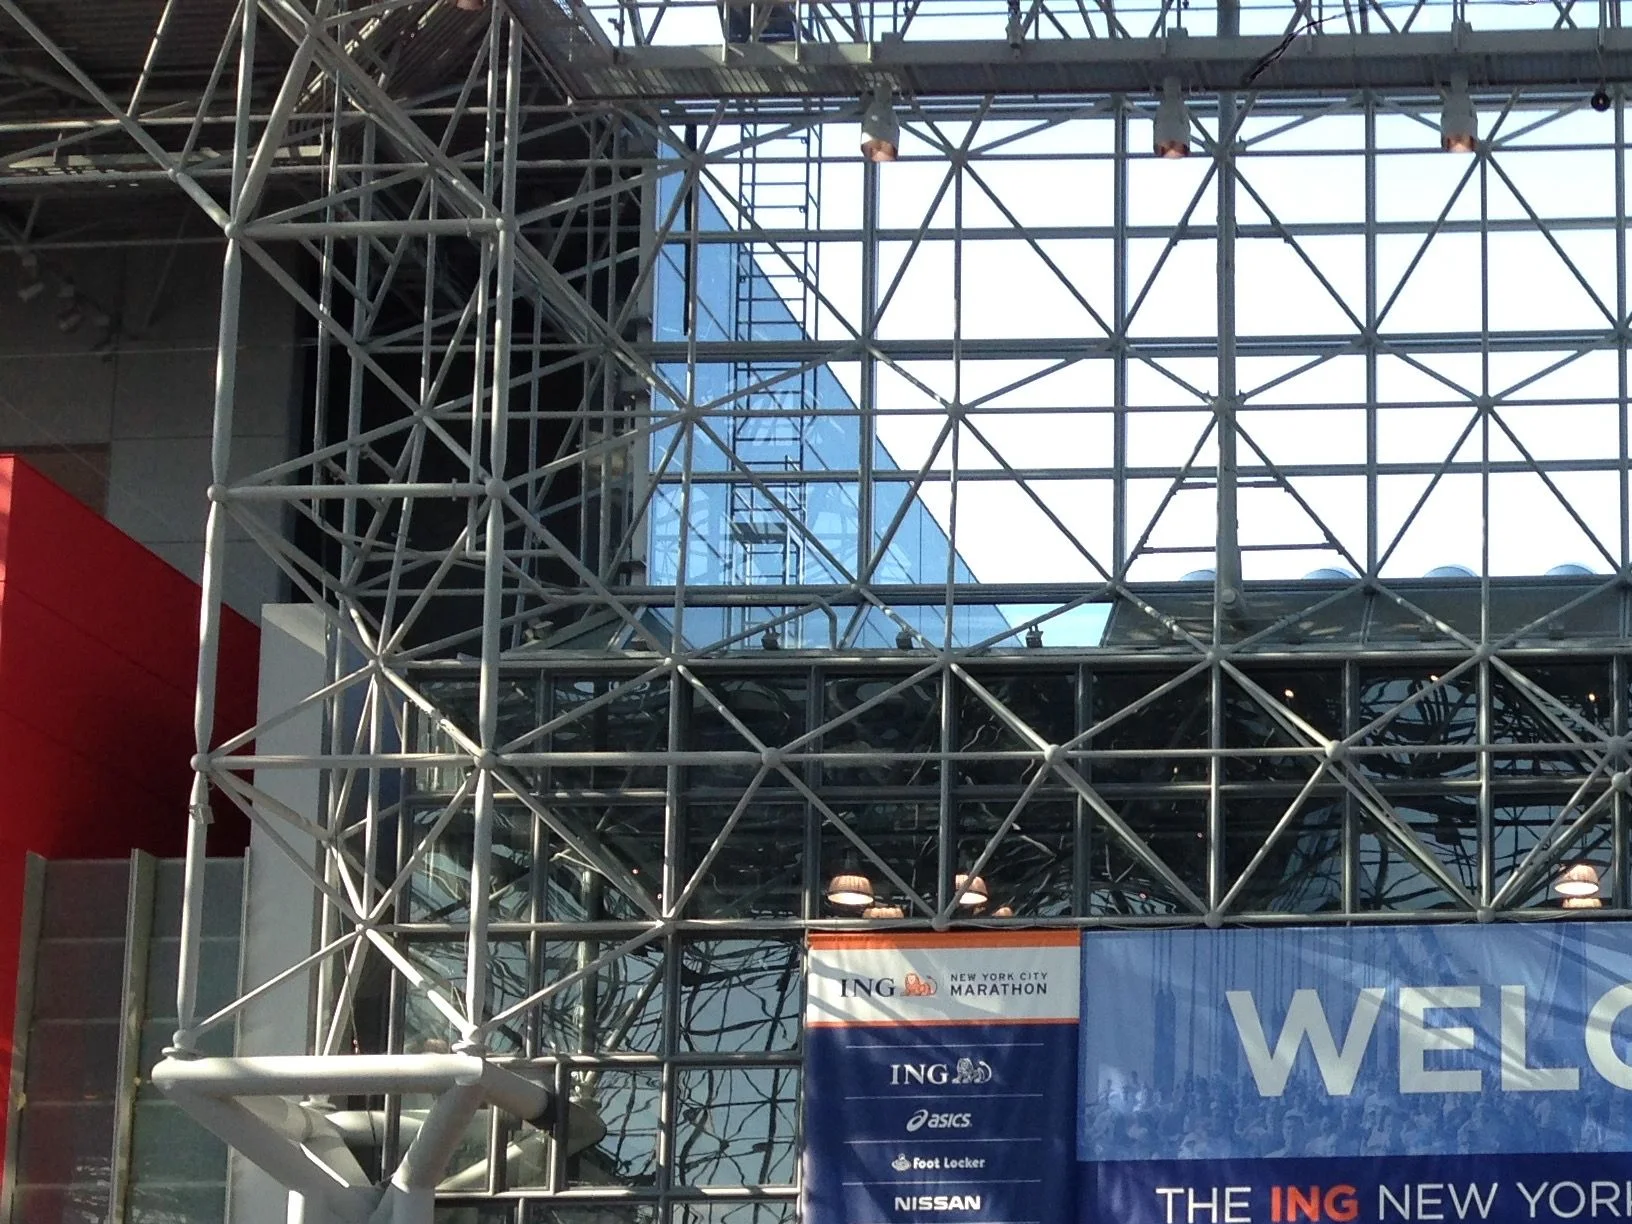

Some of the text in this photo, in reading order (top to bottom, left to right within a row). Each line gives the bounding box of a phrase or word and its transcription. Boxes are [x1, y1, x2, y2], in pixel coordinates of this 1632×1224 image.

[950, 972, 1048, 982] NEW YORK CITY
[840, 977, 895, 998] ING
[950, 983, 1048, 997] MARATHON
[890, 1064, 948, 1085] ING
[913, 1157, 985, 1170] Foot Locker
[895, 1196, 981, 1211] NISSAN
[1155, 1186, 1252, 1224] THE
[1270, 1185, 1359, 1223] ING
[1378, 1182, 1498, 1221] NEW
